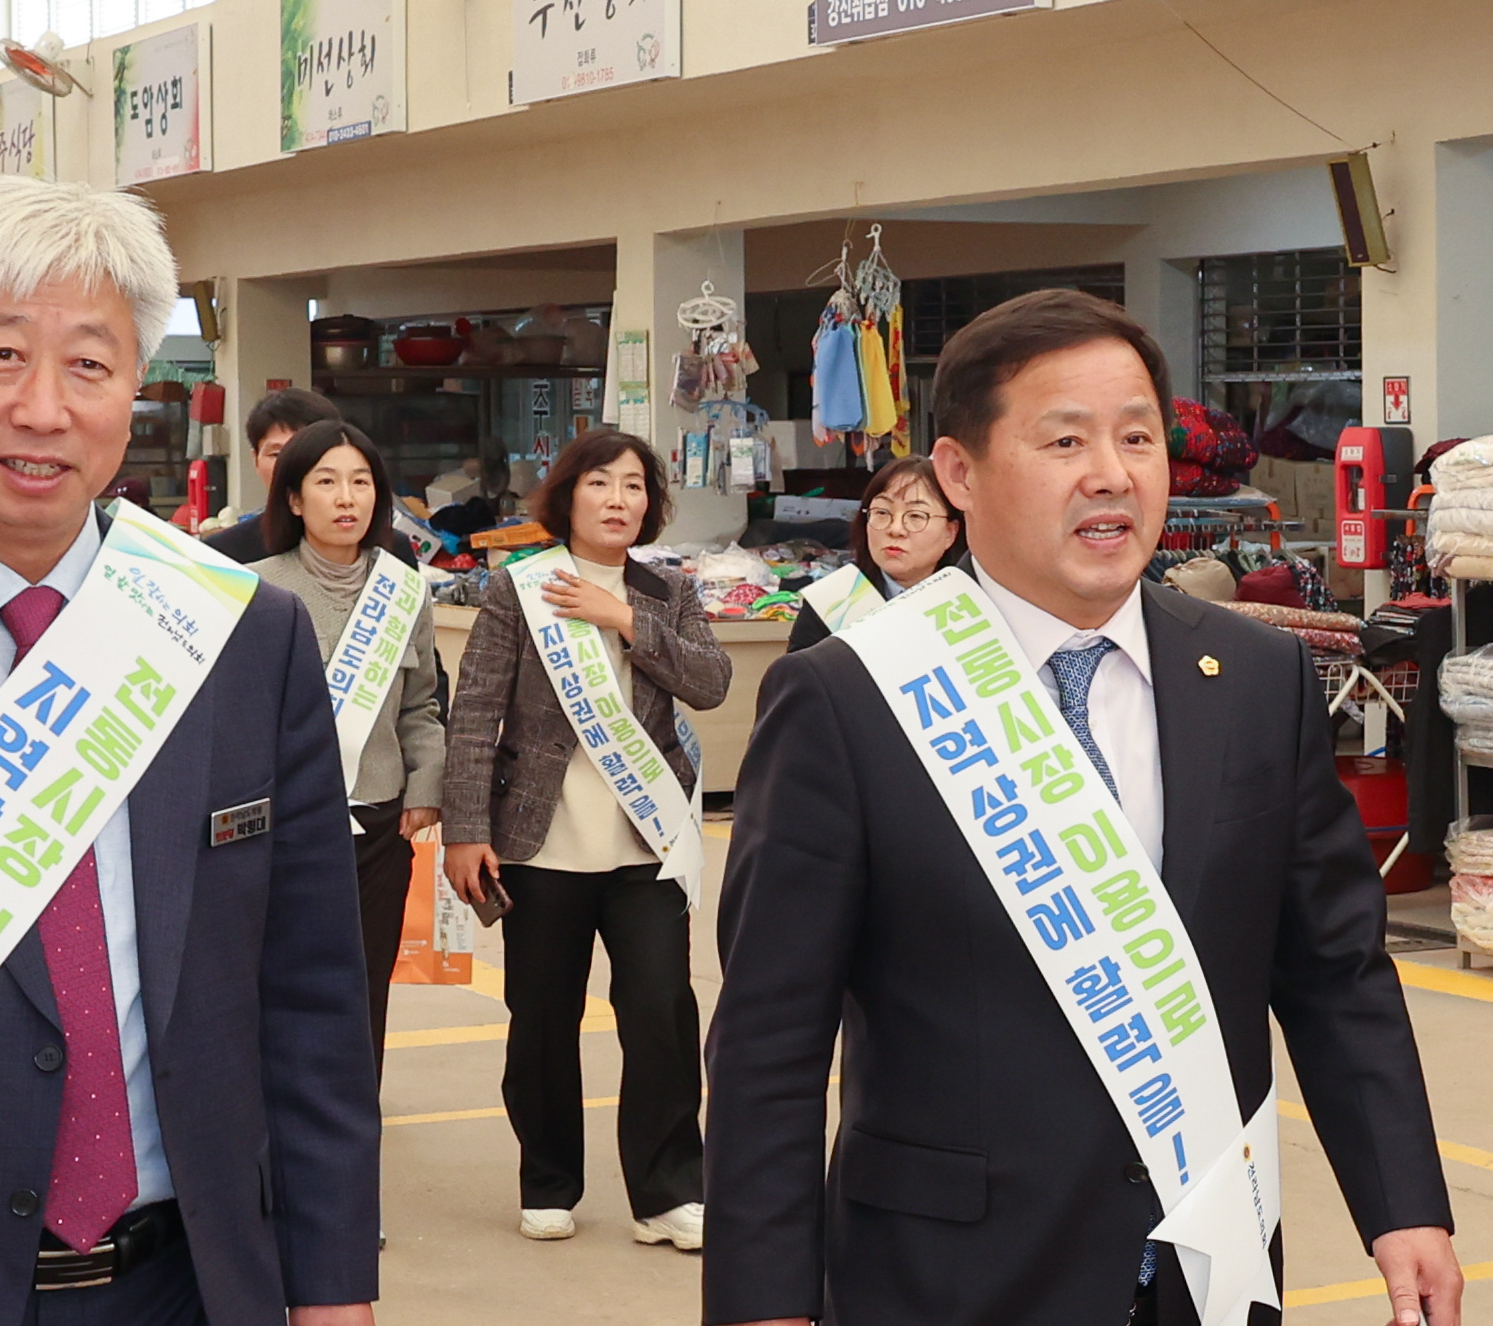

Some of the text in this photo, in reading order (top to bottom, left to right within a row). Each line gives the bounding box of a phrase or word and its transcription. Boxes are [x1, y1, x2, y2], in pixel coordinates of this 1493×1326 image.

[130, 75, 183, 139] 도암상회
[172, 609, 199, 637] 의회
[351, 569, 422, 711] 민과 함께하는
[539, 624, 608, 748] 지역상권에
[566, 618, 664, 784] 통시장 이용으로
[929, 595, 1206, 1045] 전통시장 이용으로
[900, 665, 1190, 1186] 지역상권에 활력을!
